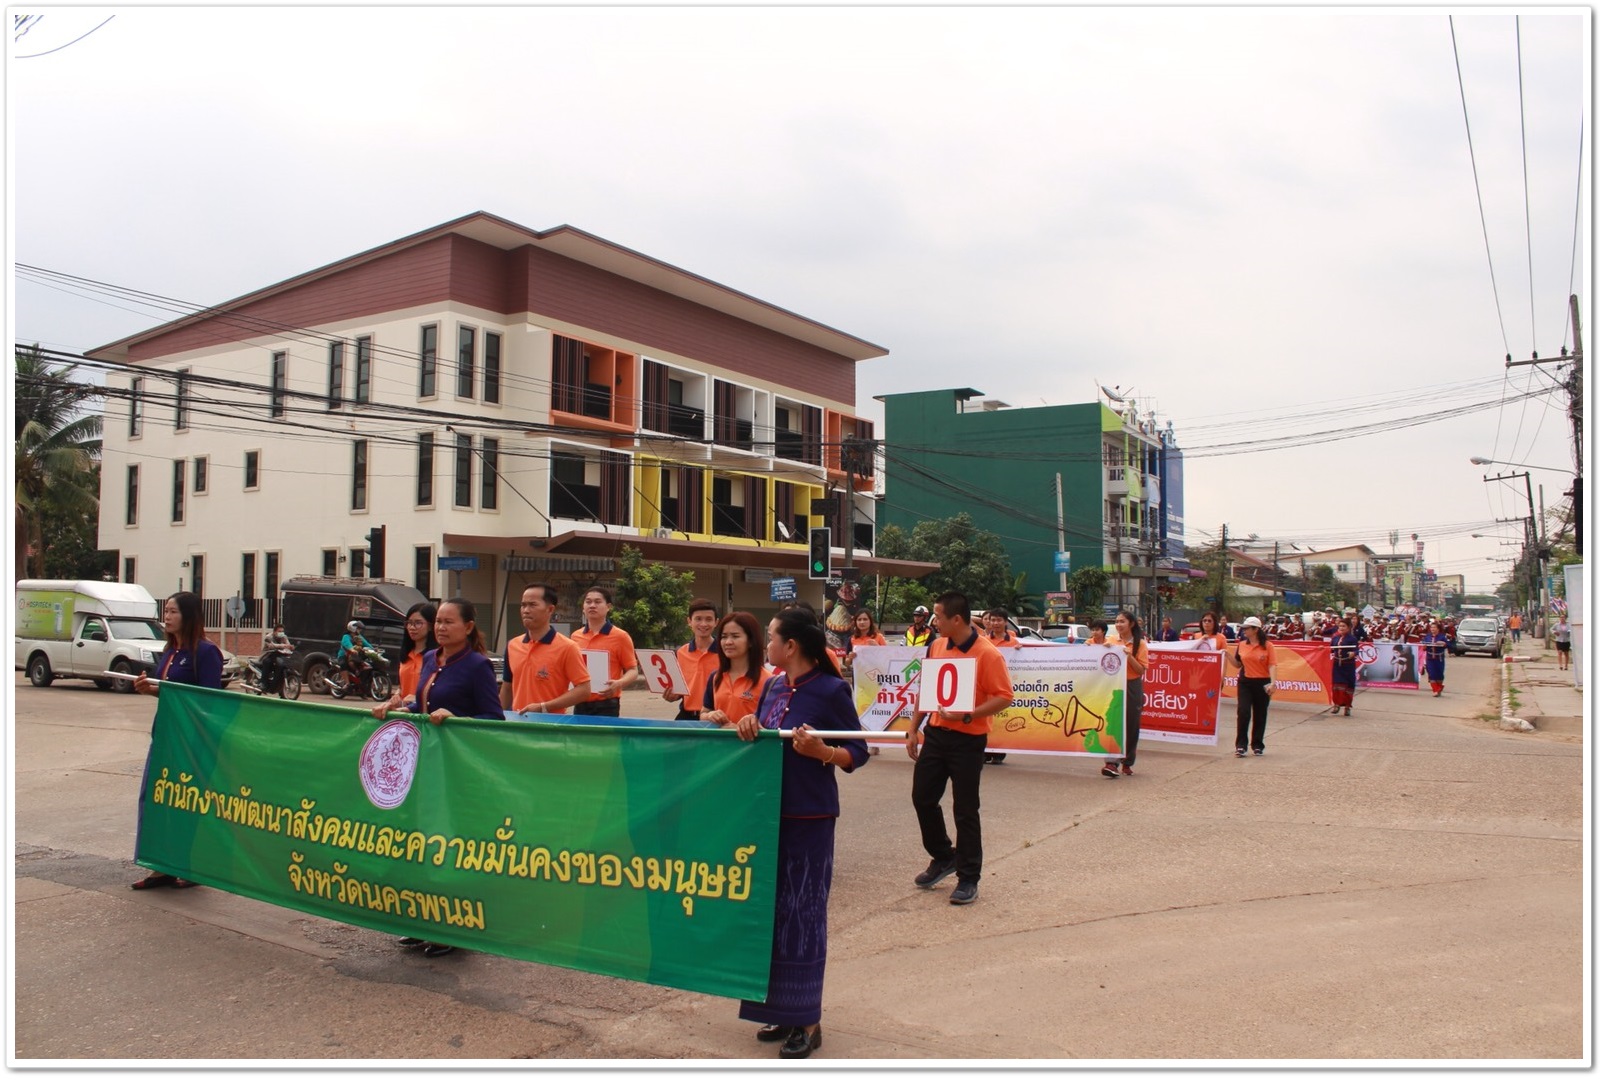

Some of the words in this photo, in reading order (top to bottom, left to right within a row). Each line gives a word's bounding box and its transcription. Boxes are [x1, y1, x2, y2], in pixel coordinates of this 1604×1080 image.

[651, 654, 673, 688] 3
[936, 663, 958, 707] 0
[1054, 680, 1074, 693] สตรี
[152, 768, 757, 915] สำนักงานพัฒนาสังคมและความมั่นคงของมนุษย์
[286, 852, 486, 930] จังหวัดนครพนม
